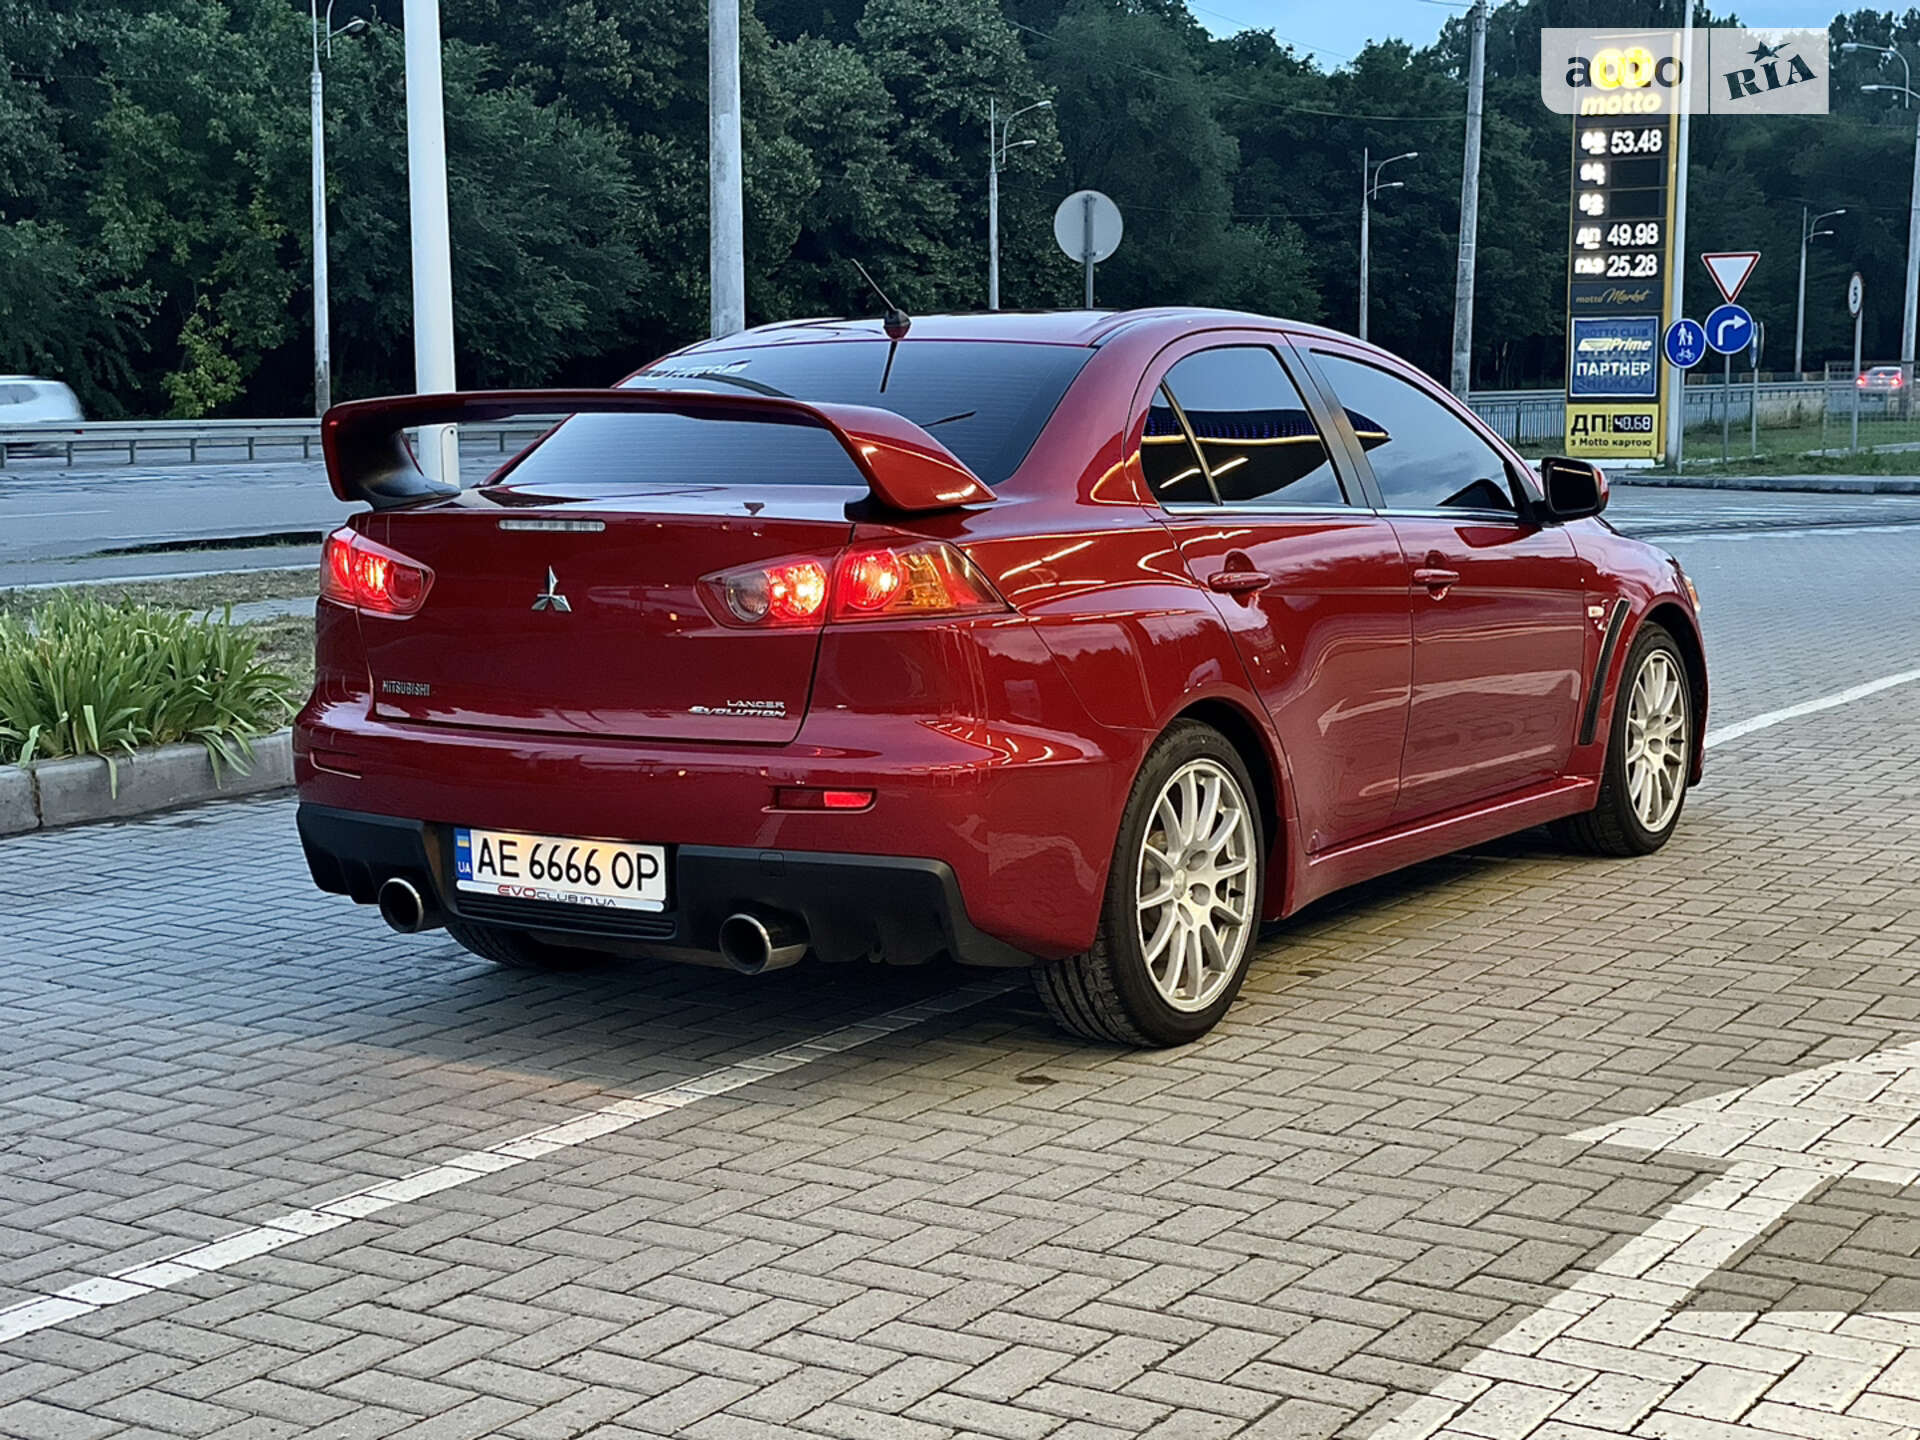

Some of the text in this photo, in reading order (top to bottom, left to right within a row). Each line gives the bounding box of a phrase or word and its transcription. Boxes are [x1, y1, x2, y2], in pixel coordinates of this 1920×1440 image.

[1611, 129, 1662, 153] 53.48
[1606, 222, 1659, 246] 49.98
[1606, 254, 1658, 277] 25.28
[1609, 337, 1653, 351] Prime
[1576, 361, 1651, 377] ПАРТНЕР
[1571, 414, 1652, 436] ДП 40.68
[1579, 437, 1609, 446] Motto
[1612, 439, 1652, 448] картою
[382, 680, 431, 697] MITSUBISHI
[687, 705, 786, 718] EVOLUTION
[726, 699, 785, 709] LANCER
[457, 861, 472, 874] UA
[477, 837, 659, 892] AE 6666 OP
